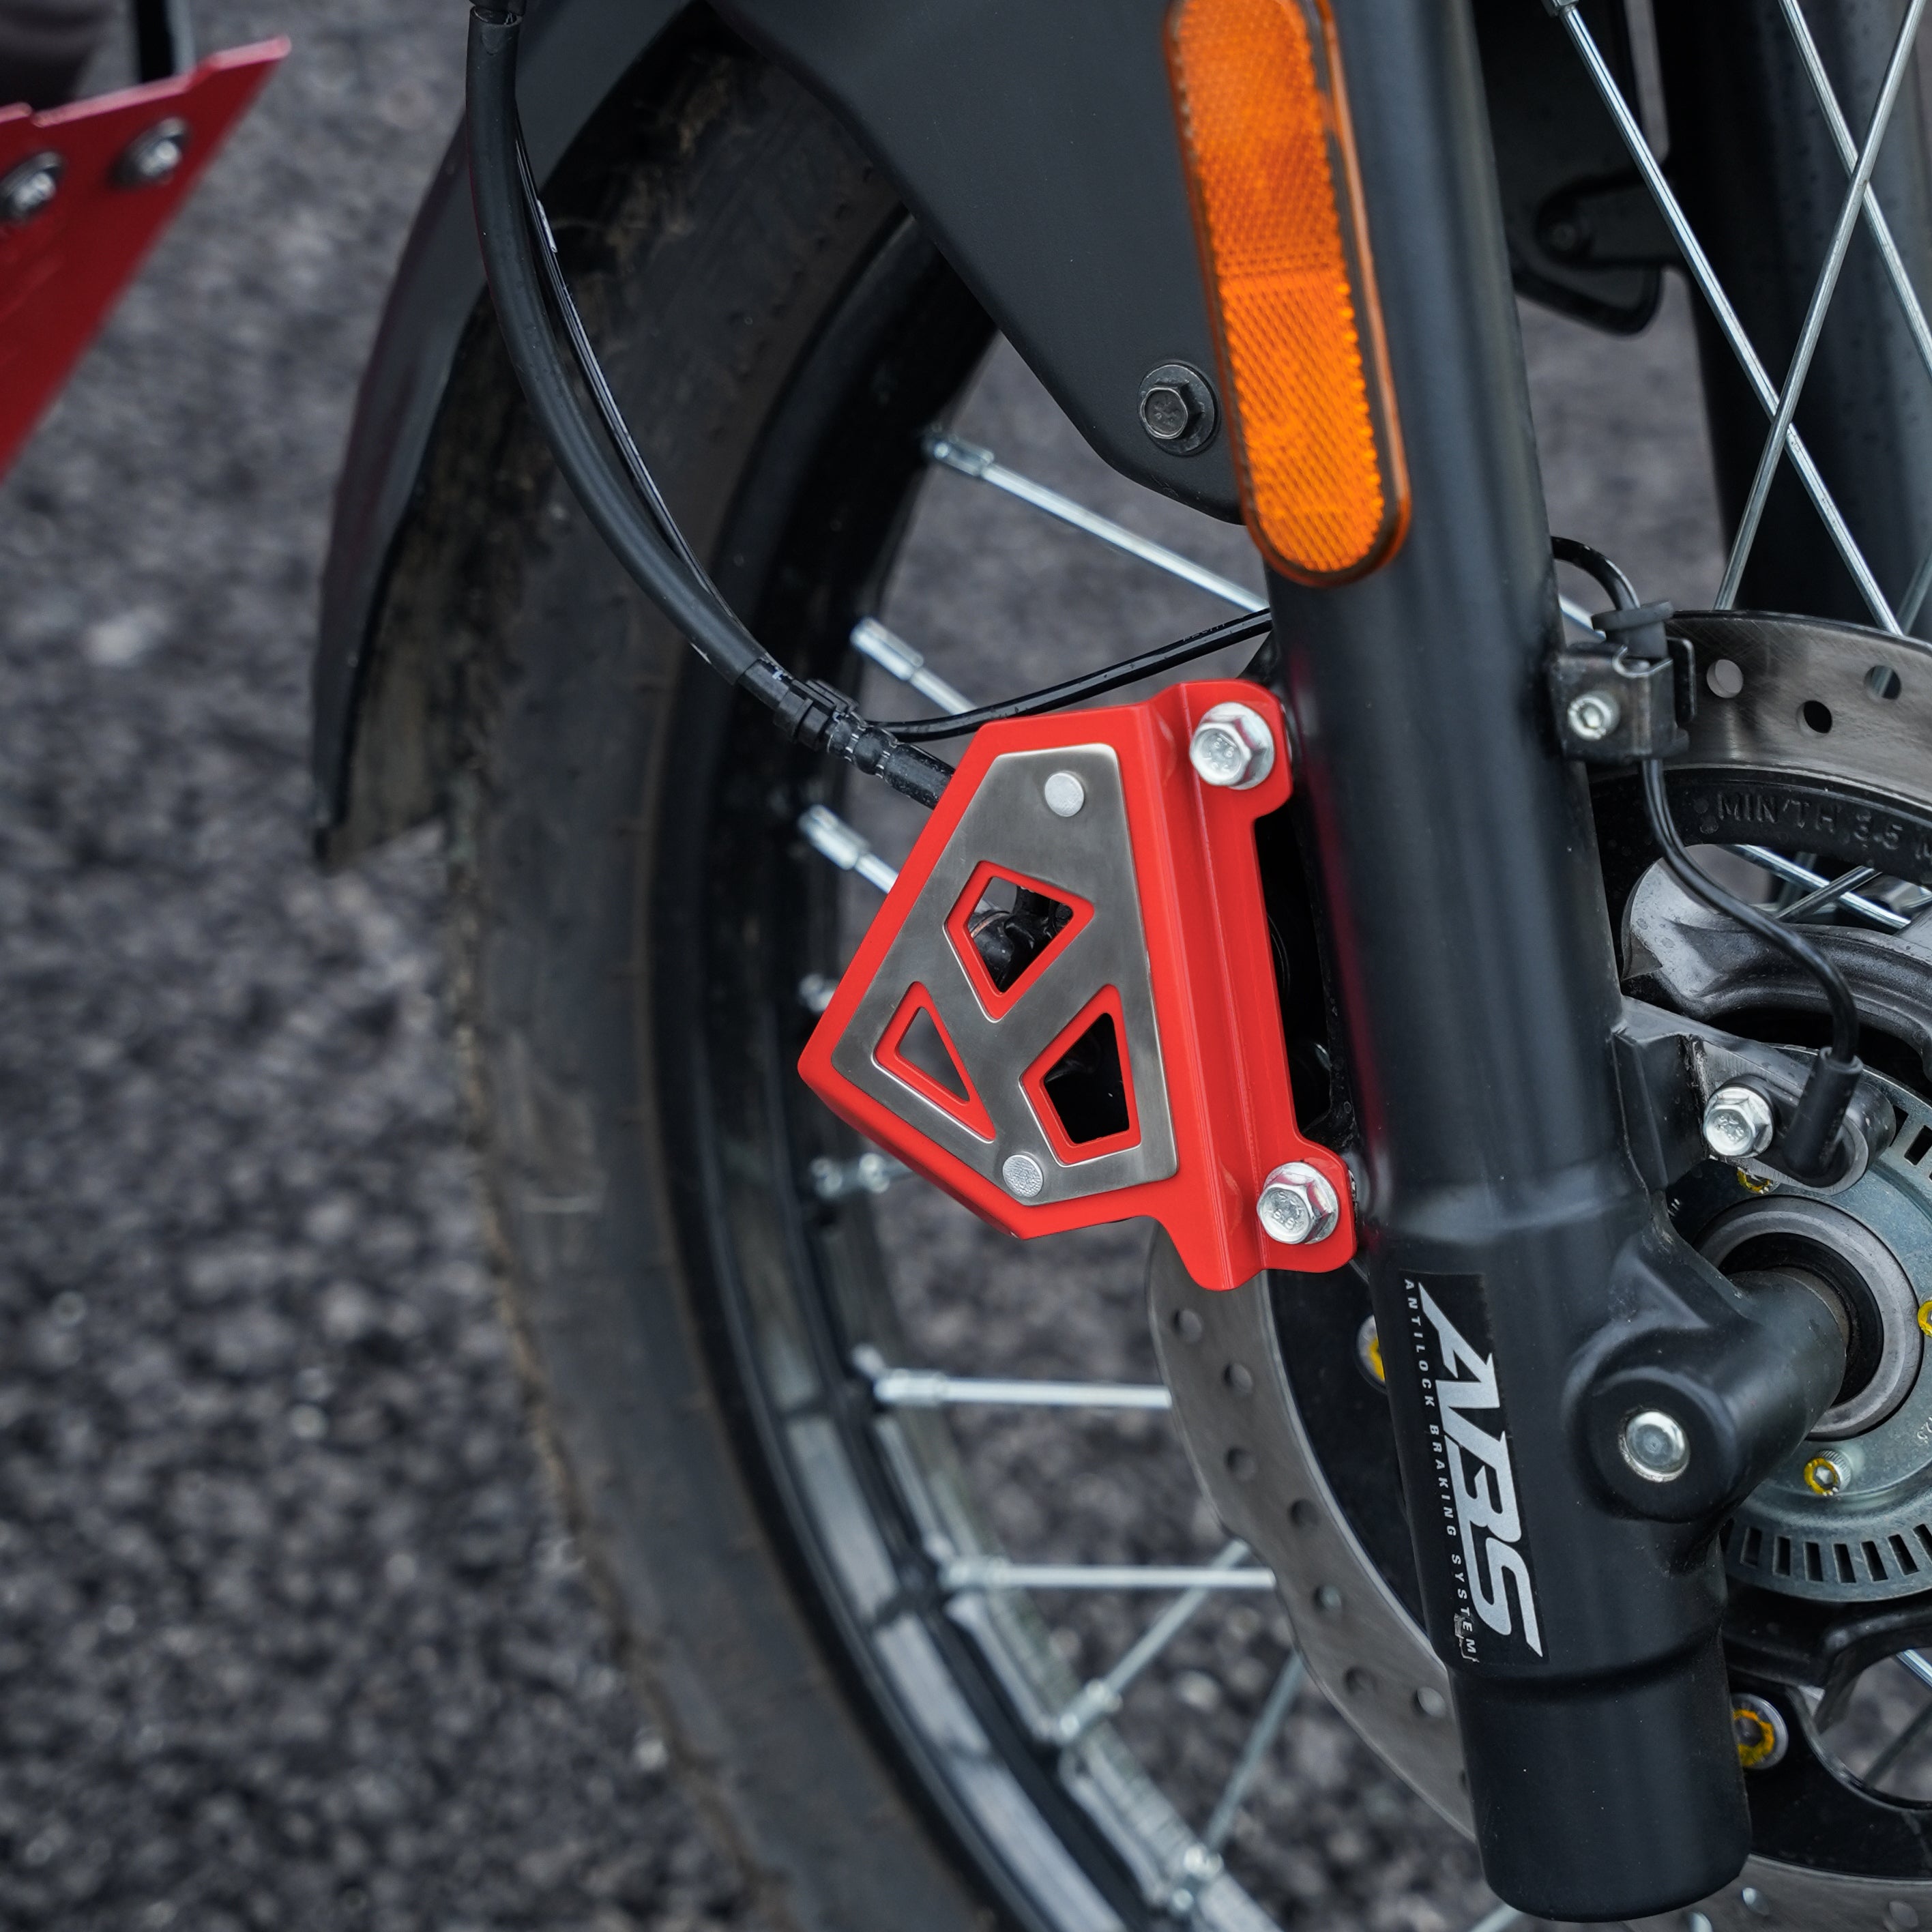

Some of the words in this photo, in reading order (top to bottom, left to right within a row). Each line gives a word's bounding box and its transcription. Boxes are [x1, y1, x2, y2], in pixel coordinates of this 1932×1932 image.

[1404, 1278, 1435, 1407] ANTILOCK
[1429, 1424, 1457, 1537] BRAKING
[1452, 1553, 1476, 1654] SYSTEM
[1418, 1282, 1543, 1657] ABS
